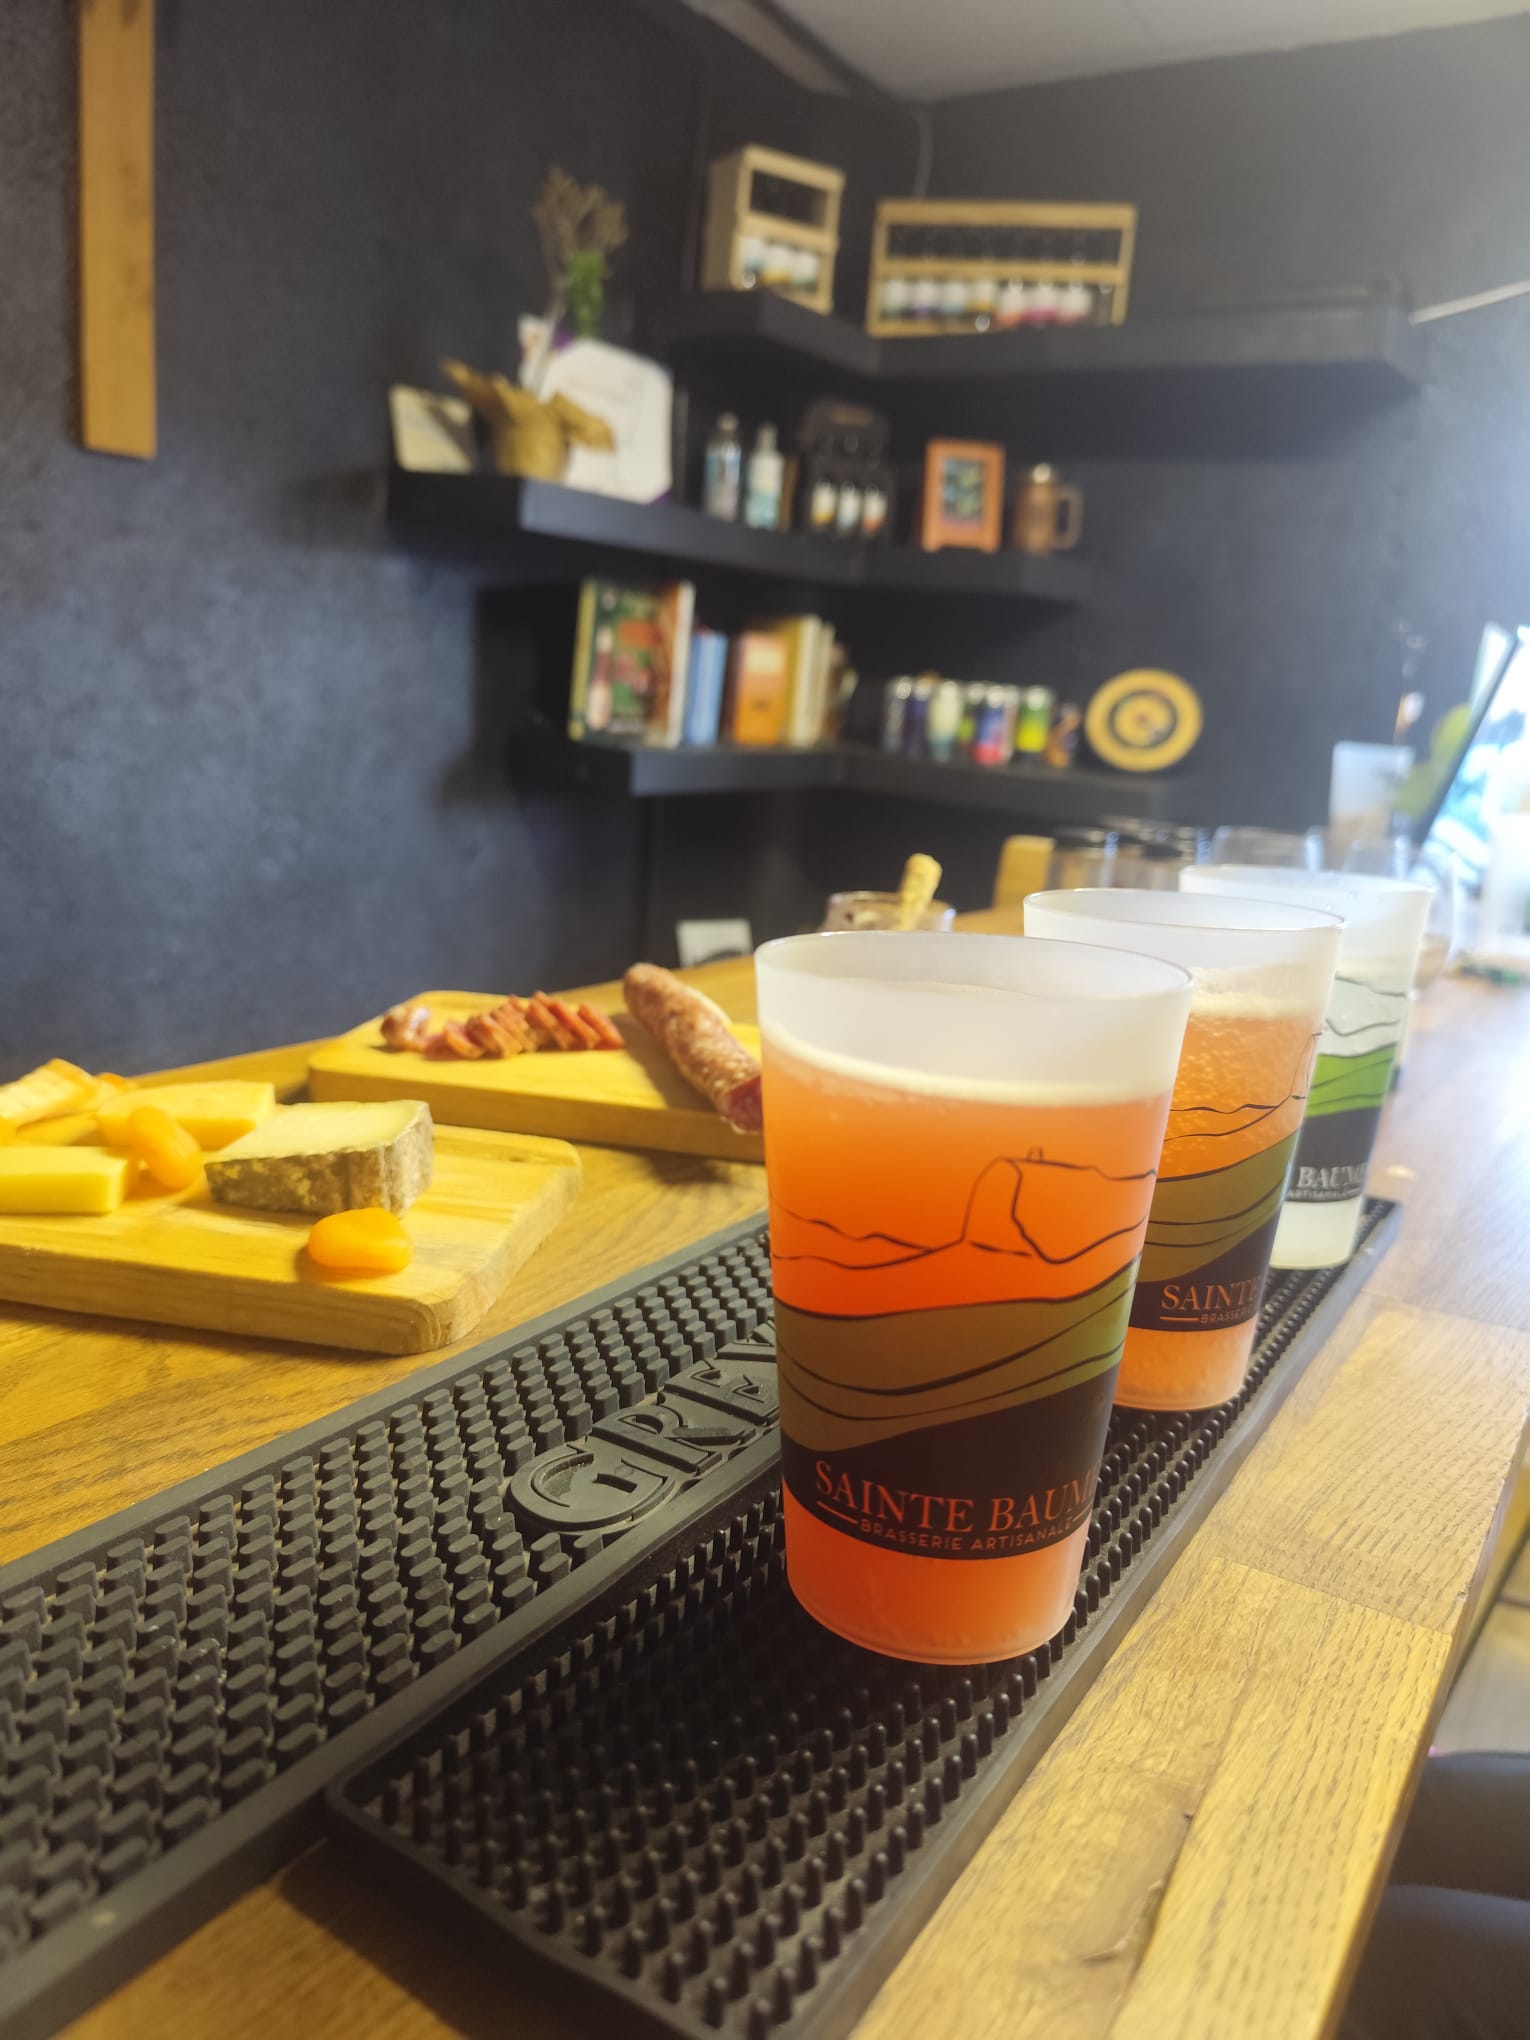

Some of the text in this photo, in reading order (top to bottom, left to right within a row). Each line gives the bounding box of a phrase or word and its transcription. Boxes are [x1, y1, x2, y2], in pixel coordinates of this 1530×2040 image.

[815, 1460, 974, 1532] SAINTE
[859, 1515, 1073, 1551] BRASSERIE ARTISANALE
